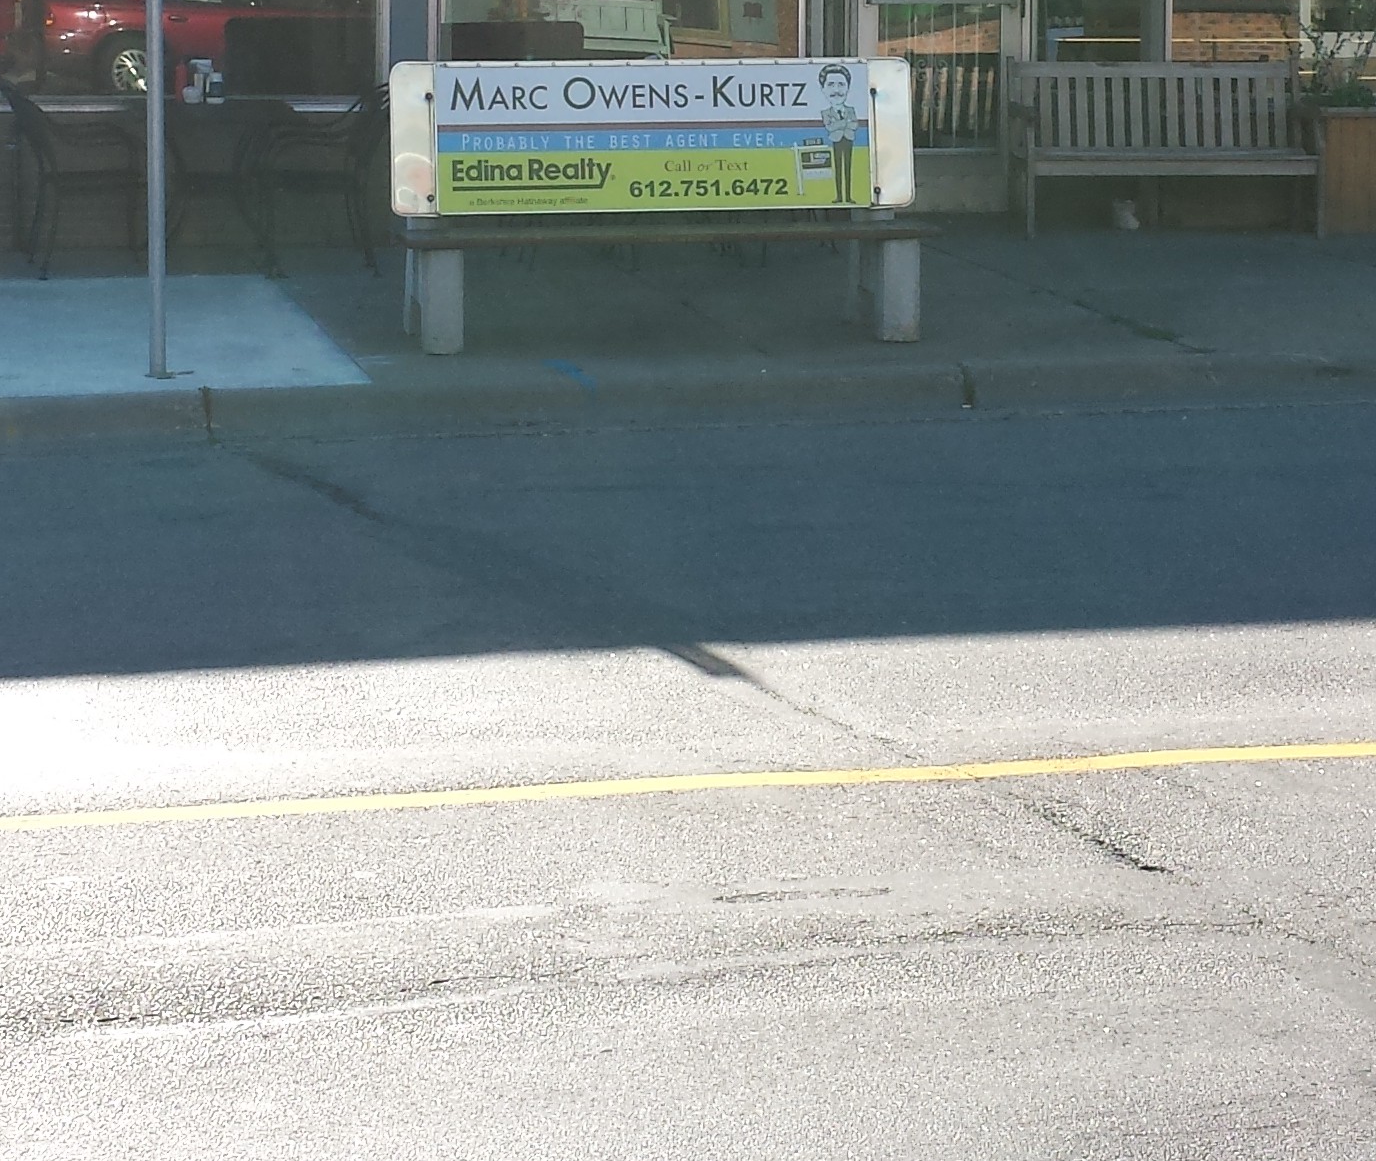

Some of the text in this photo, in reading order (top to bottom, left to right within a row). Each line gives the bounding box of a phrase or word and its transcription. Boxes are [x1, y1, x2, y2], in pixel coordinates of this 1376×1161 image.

[564, 136, 595, 149] THE
[609, 135, 652, 148] BEST
[665, 134, 719, 148] AGENT
[452, 158, 612, 189] Edina Realty
[664, 159, 749, 172] Call or Text
[629, 178, 789, 198] 612.751.6472
